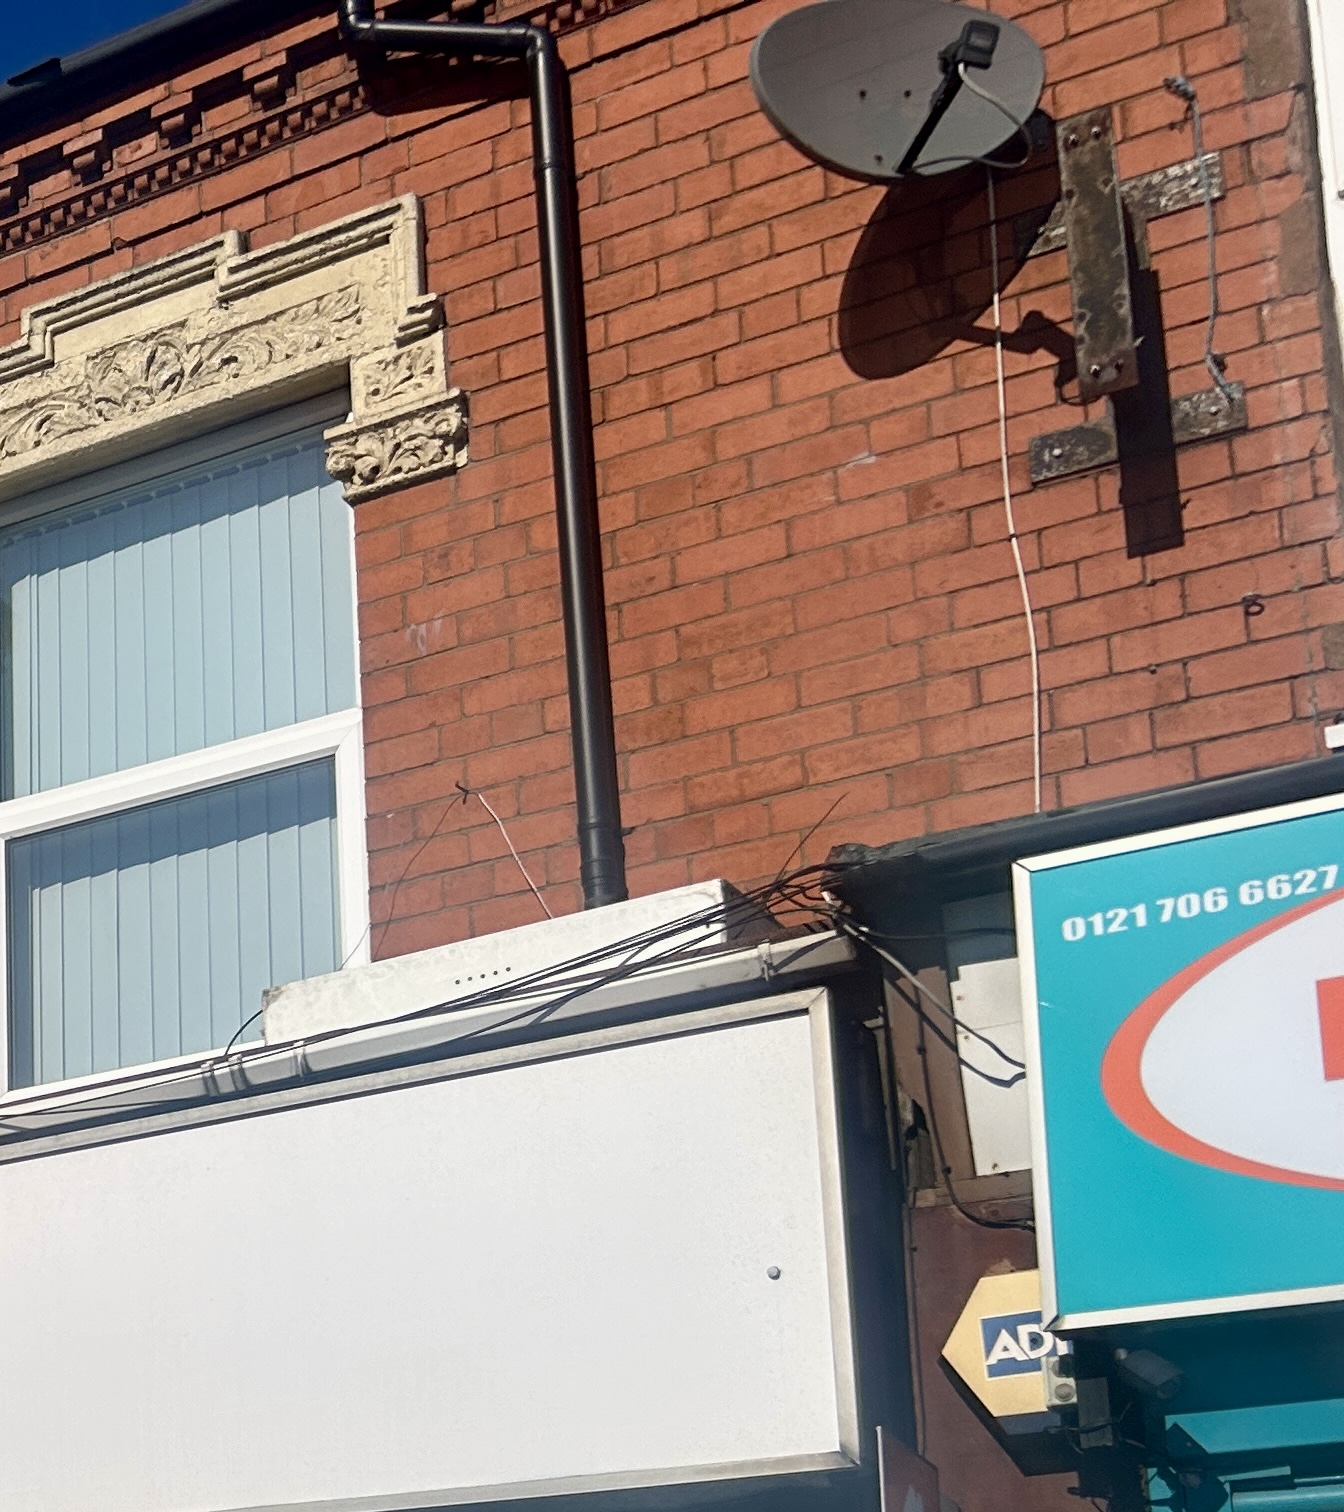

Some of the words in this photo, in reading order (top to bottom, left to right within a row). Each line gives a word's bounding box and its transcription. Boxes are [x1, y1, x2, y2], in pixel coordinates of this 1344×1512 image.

[1061, 904, 1147, 943] 0121
[1158, 888, 1229, 924] 706
[1239, 864, 1339, 907] 6627
